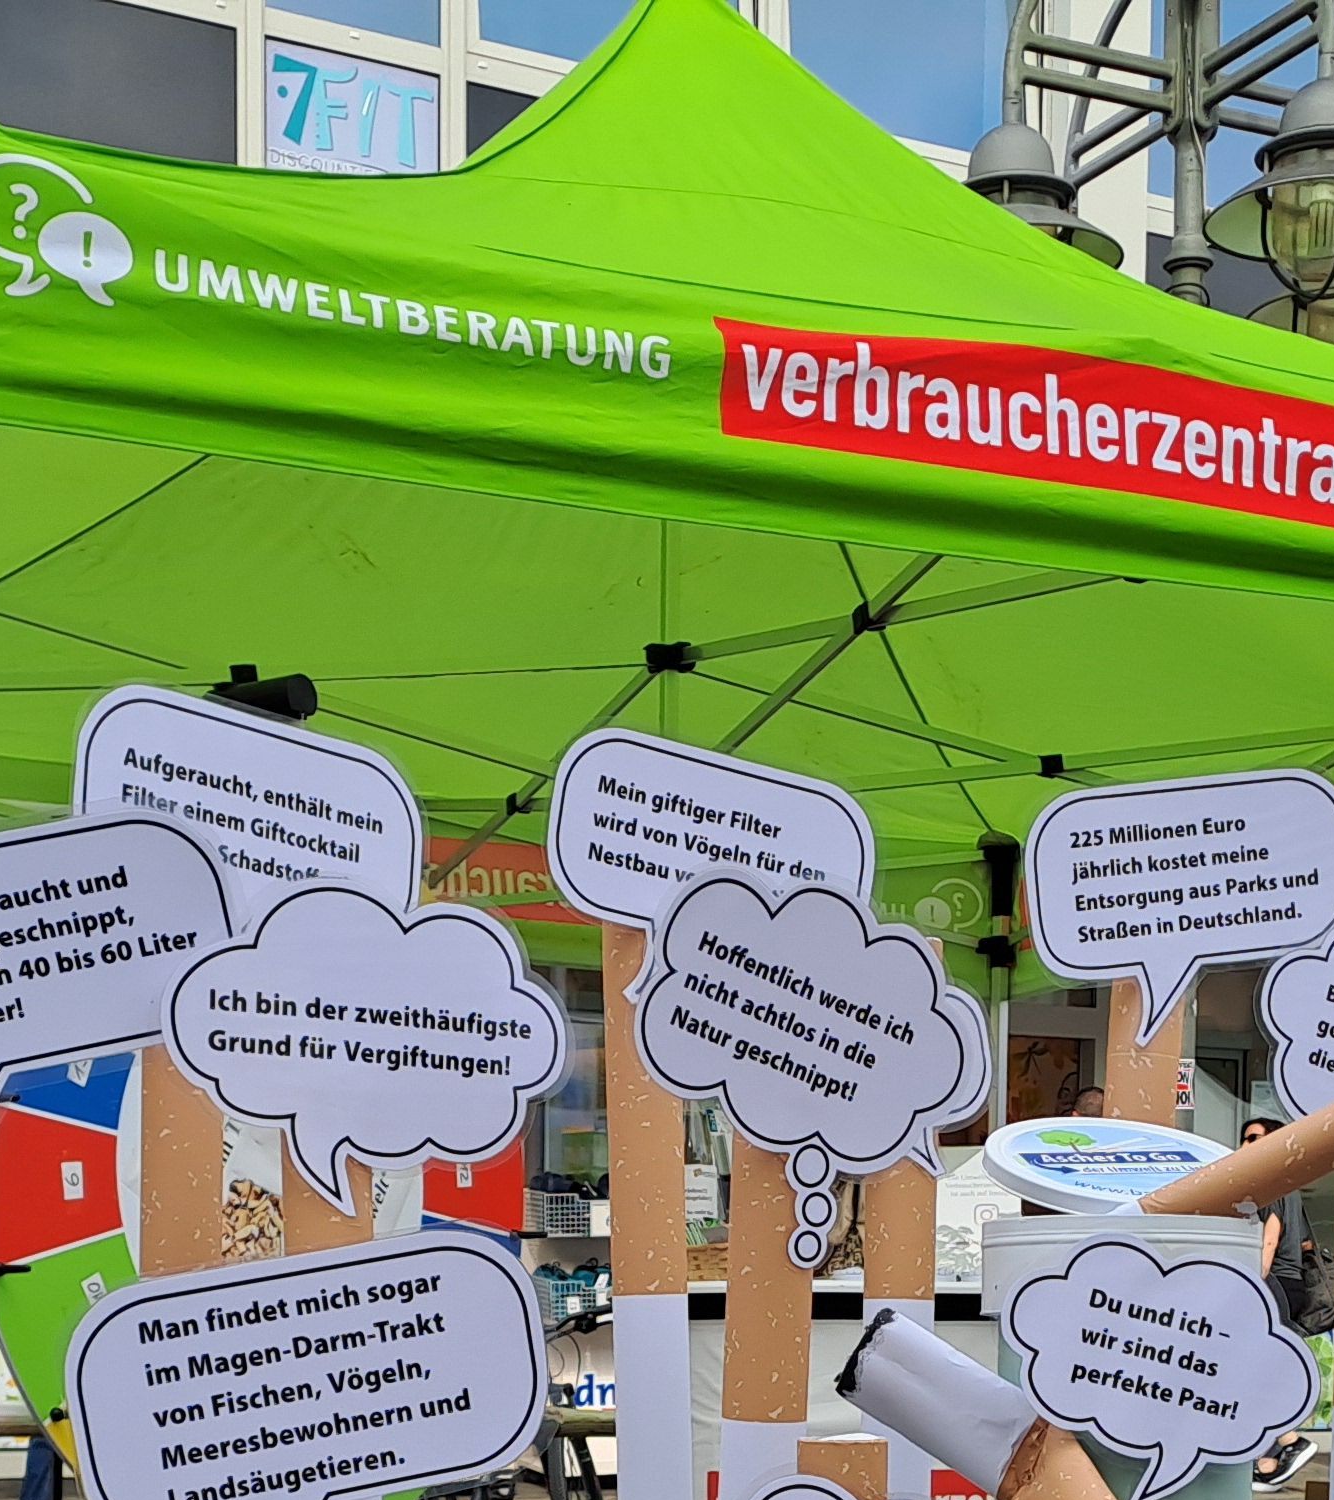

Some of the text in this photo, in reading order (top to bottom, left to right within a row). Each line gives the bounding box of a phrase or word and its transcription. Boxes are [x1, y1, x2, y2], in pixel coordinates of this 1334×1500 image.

[272, 53, 434, 169] 7FIT
[154, 247, 671, 379] UMWELTBERATUNG
[1069, 817, 1245, 848] 225 Millionen Euro
[1071, 844, 1268, 885] jährlich kostet meine
[1074, 867, 1318, 911] Entsorgung aus Parks und
[1077, 901, 1302, 942] Straßen in Deutschland.
[683, 973, 875, 1068] nicht achtlos in die
[697, 930, 913, 1044] Hoffentlich werde ich
[669, 1004, 857, 1101] Natur geschnippt!
[138, 1274, 440, 1344] Man findet mich sogar
[144, 1312, 445, 1386] im Magen-Darm-Trakt
[152, 1358, 430, 1427] von Fischen, Vögeln,
[160, 1387, 470, 1469] Meeresbewohnern und
